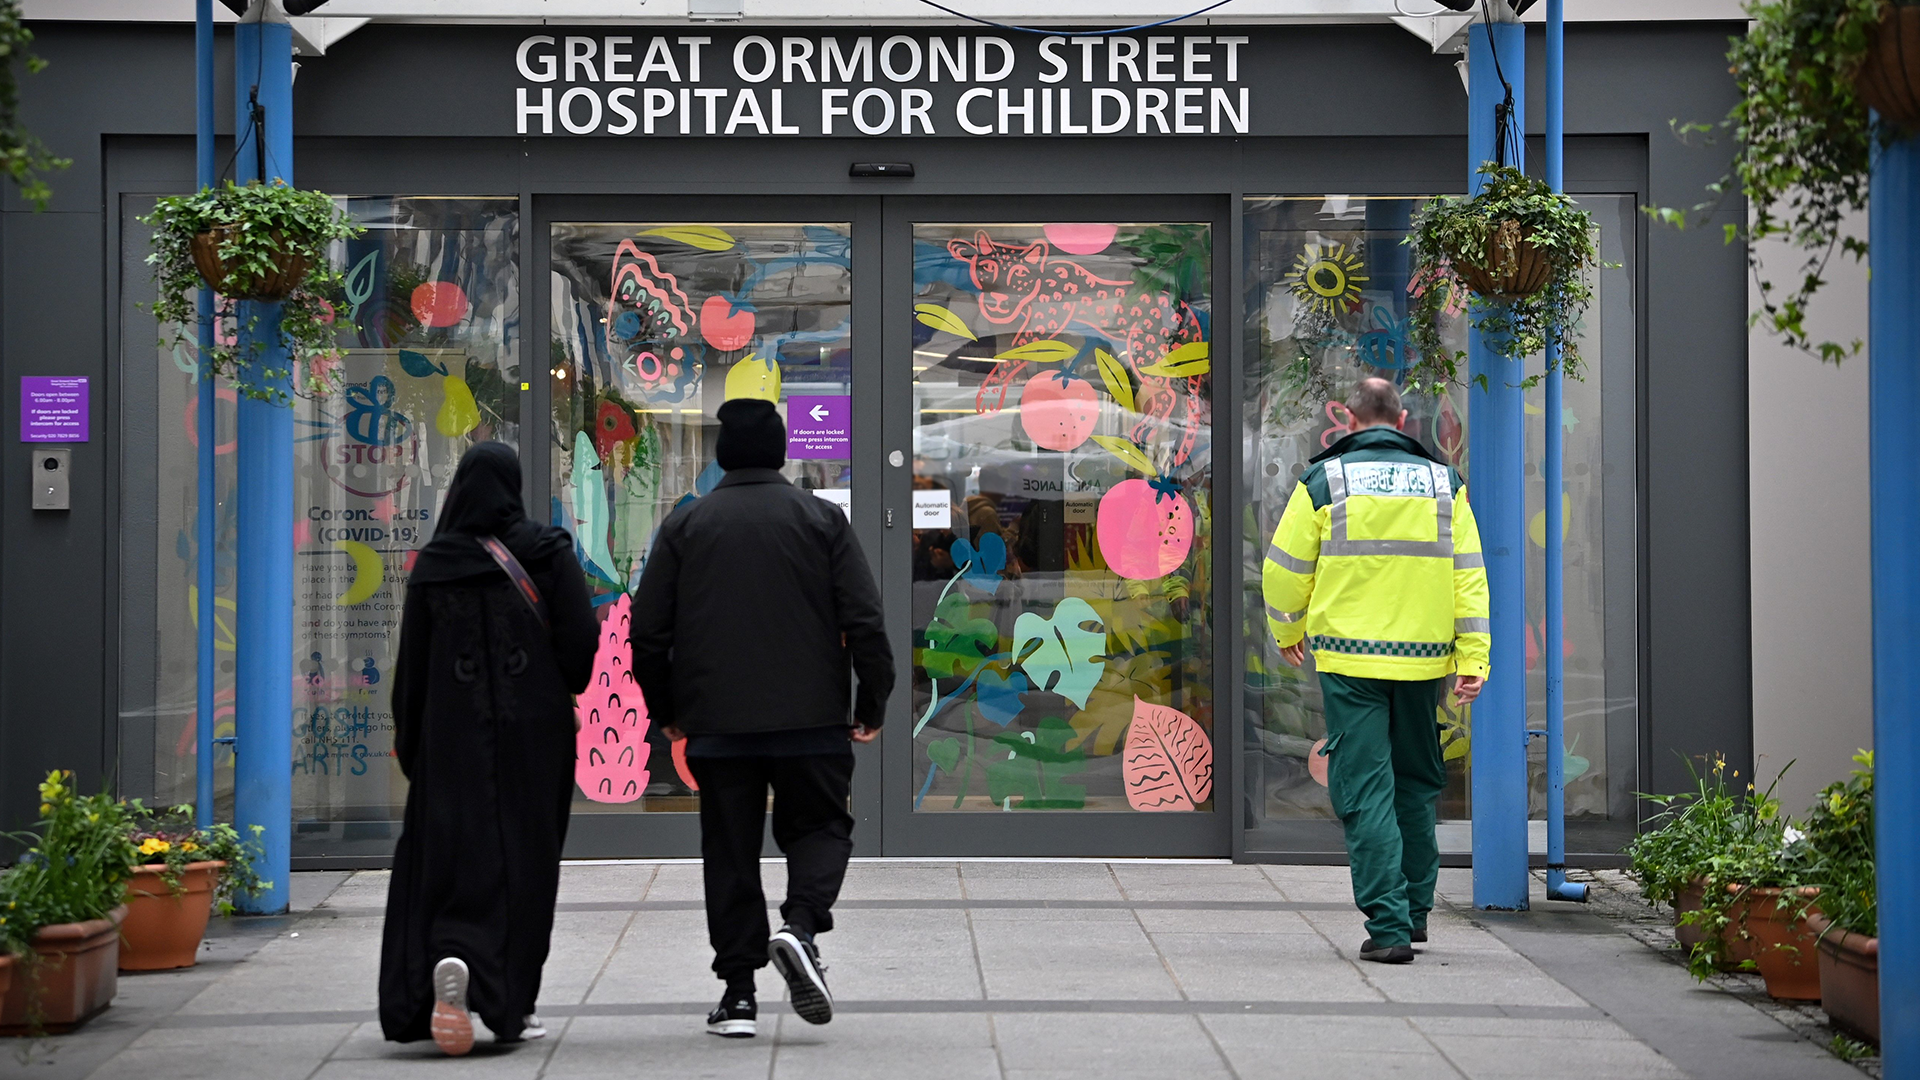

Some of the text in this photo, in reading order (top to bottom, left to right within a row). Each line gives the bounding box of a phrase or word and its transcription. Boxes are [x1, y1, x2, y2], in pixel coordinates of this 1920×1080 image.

[517, 36, 1248, 83] GREAT ORMOND STREET
[517, 87, 1248, 134] HOSPITAL FOR CHILDREN
[336, 445, 404, 464] STOP
[307, 507, 430, 521] Coronairus
[923, 509, 940, 517] door
[318, 527, 419, 544] (COVID-19)
[302, 563, 325, 572] Have
[326, 565, 344, 573] you
[302, 575, 326, 584] place
[328, 575, 336, 583] in
[340, 575, 355, 583] the
[315, 591, 333, 600] had
[371, 591, 392, 599] with
[301, 603, 349, 613] somebody
[350, 603, 372, 611] with
[301, 619, 398, 629] and do you have any
[314, 630, 339, 639] these
[340, 630, 391, 641] symptoms?
[291, 705, 369, 739] GOSH
[342, 712, 375, 722] protect
[367, 725, 378, 734] go
[301, 736, 316, 745] call
[318, 736, 338, 744] NHS
[291, 743, 368, 777] ARTS
